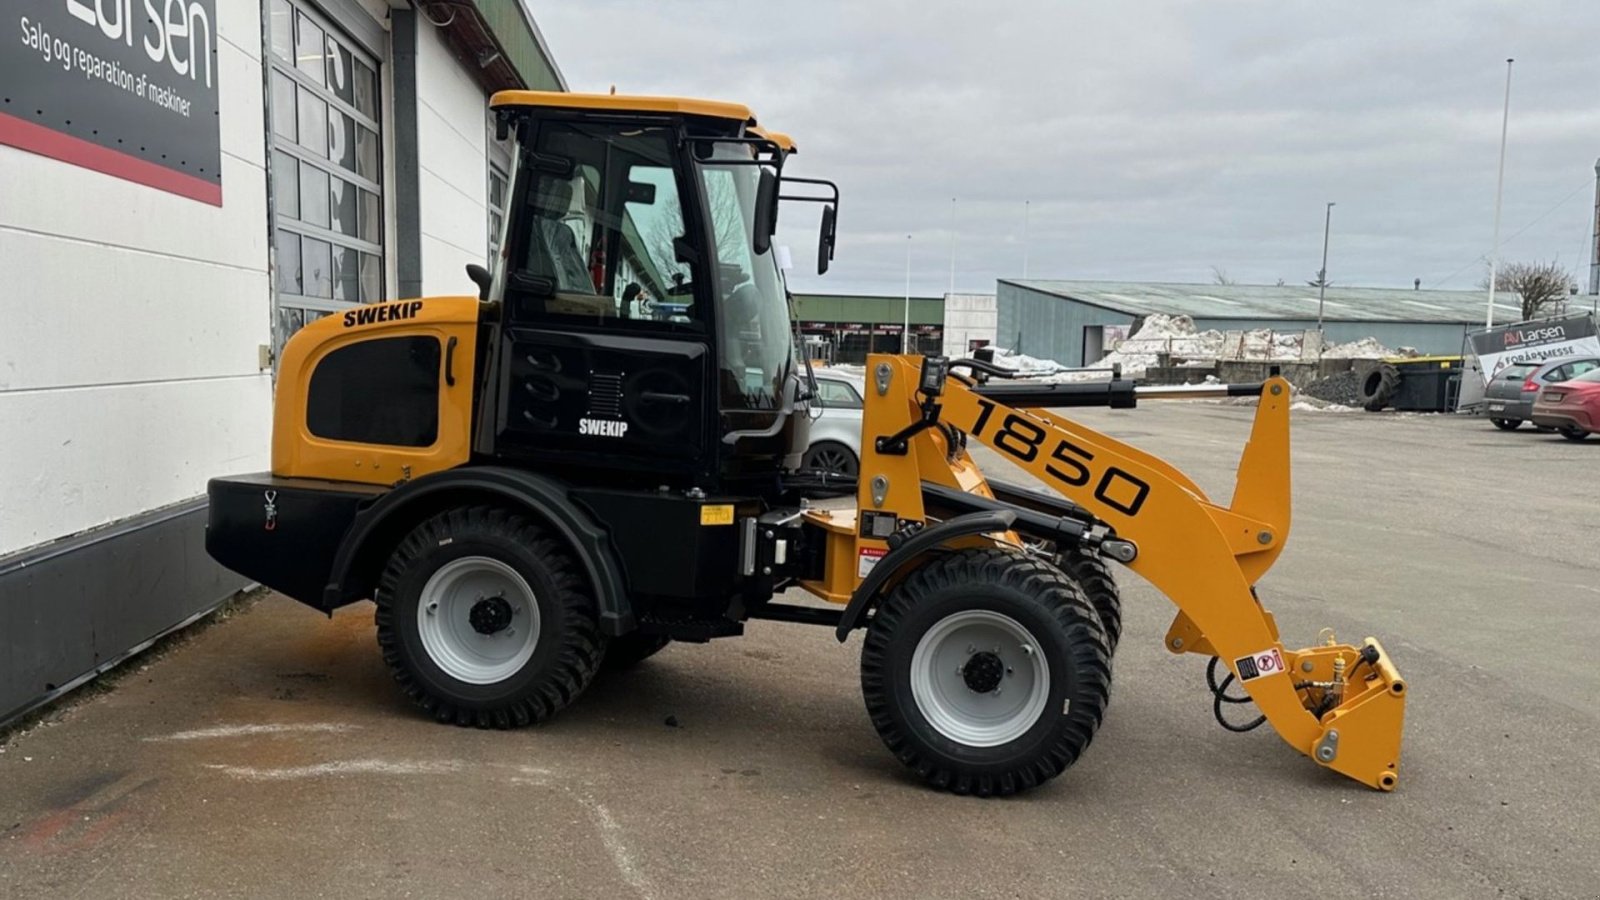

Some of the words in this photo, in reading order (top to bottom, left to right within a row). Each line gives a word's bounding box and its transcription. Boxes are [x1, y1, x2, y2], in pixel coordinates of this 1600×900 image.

[21, 16, 51, 62] Salg
[54, 38, 71, 71] og
[73, 47, 134, 93] reparation
[136, 74, 148, 97] af
[149, 82, 191, 117] maskiner
[67, 0, 212, 88] sen
[343, 300, 423, 328] SWEKIP
[578, 418, 628, 437] SWEKIP
[971, 398, 1151, 517] 1850
